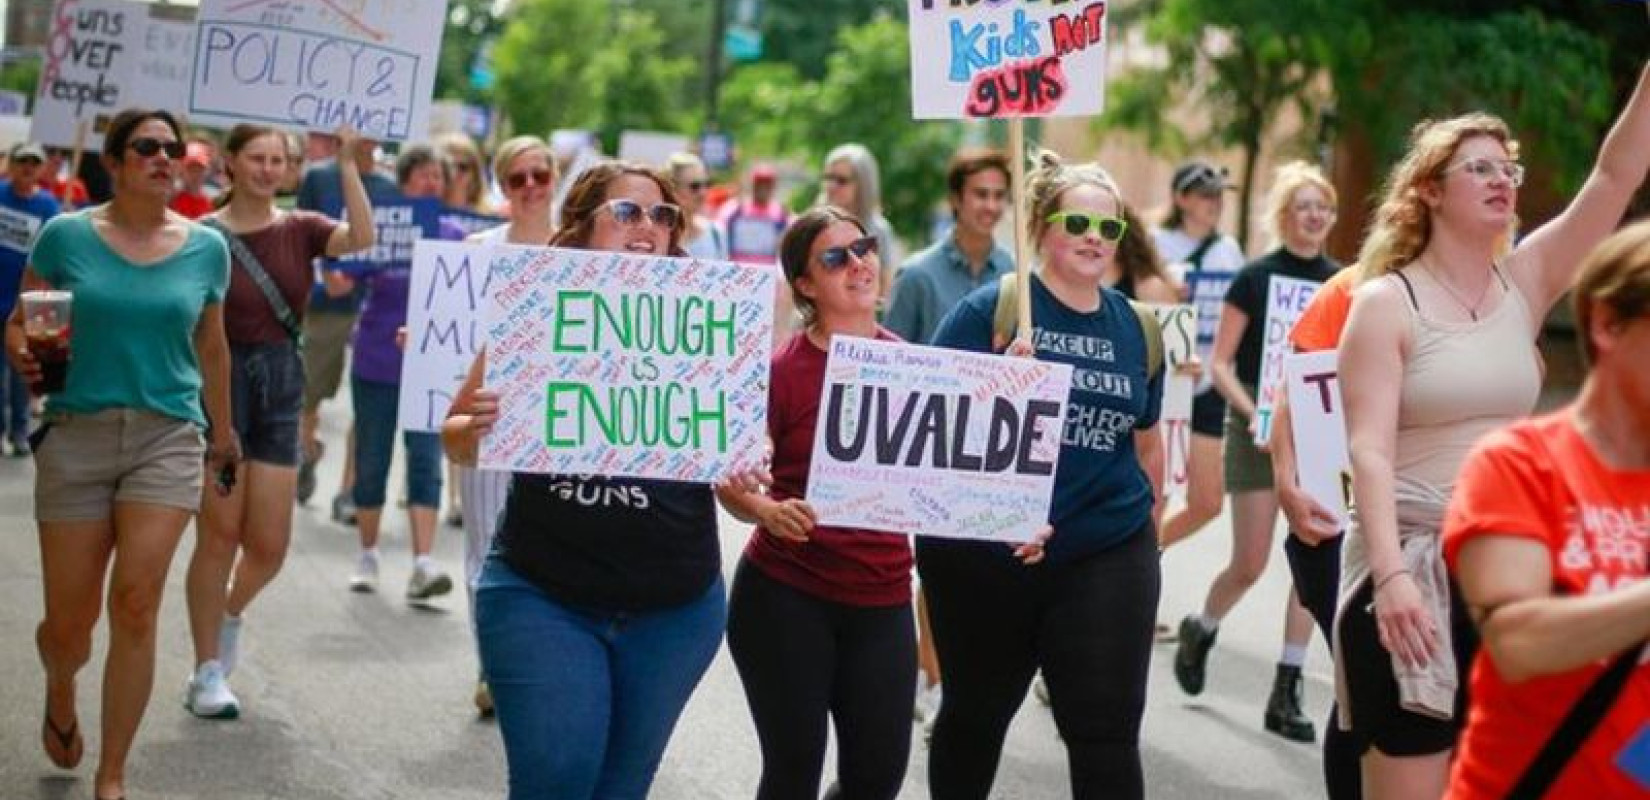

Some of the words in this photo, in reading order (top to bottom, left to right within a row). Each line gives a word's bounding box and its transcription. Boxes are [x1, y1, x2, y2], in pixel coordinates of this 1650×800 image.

[203, 27, 366, 95] POLICY
[366, 56, 395, 97] &
[949, 9, 1040, 82] Kids
[289, 93, 411, 139] CHANGE
[553, 290, 737, 357] ENOUGH
[1275, 283, 1313, 312] WE
[547, 382, 727, 453] ENOUGH
[825, 383, 1061, 476] UVALDE
